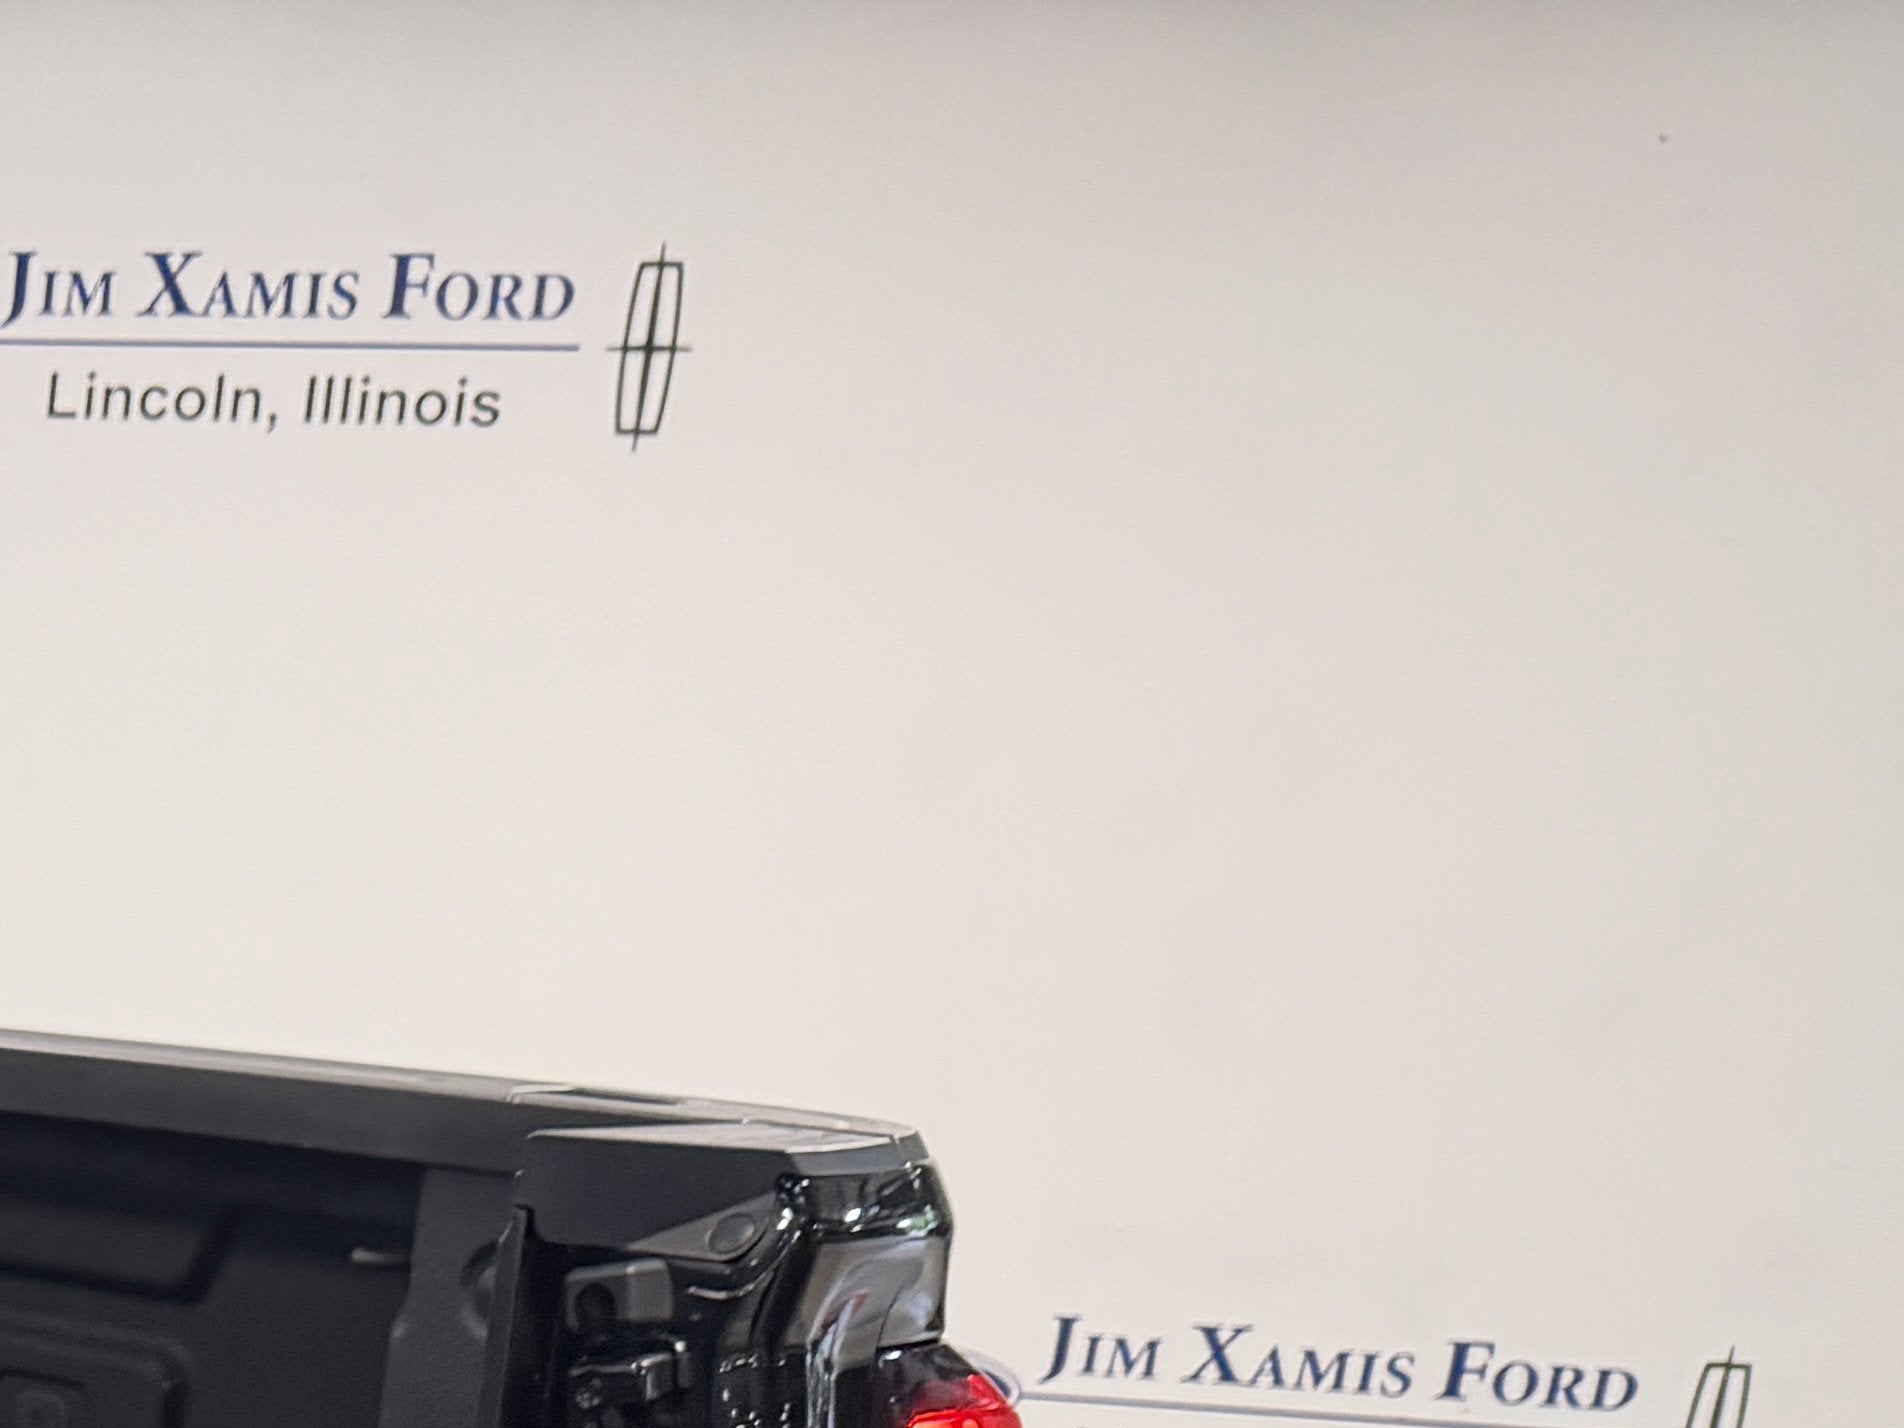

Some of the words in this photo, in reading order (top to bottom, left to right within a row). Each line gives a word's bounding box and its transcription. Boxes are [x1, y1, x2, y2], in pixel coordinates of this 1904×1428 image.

[0, 250, 115, 329] JIM
[136, 250, 360, 320] XAMIS
[381, 251, 577, 322] FORD
[45, 371, 280, 434] Lincoln,
[303, 375, 502, 429] Illinois
[1038, 1314, 1165, 1385] JIM
[1181, 1323, 1417, 1399] XAMIS
[1437, 1338, 1641, 1413] FORD
